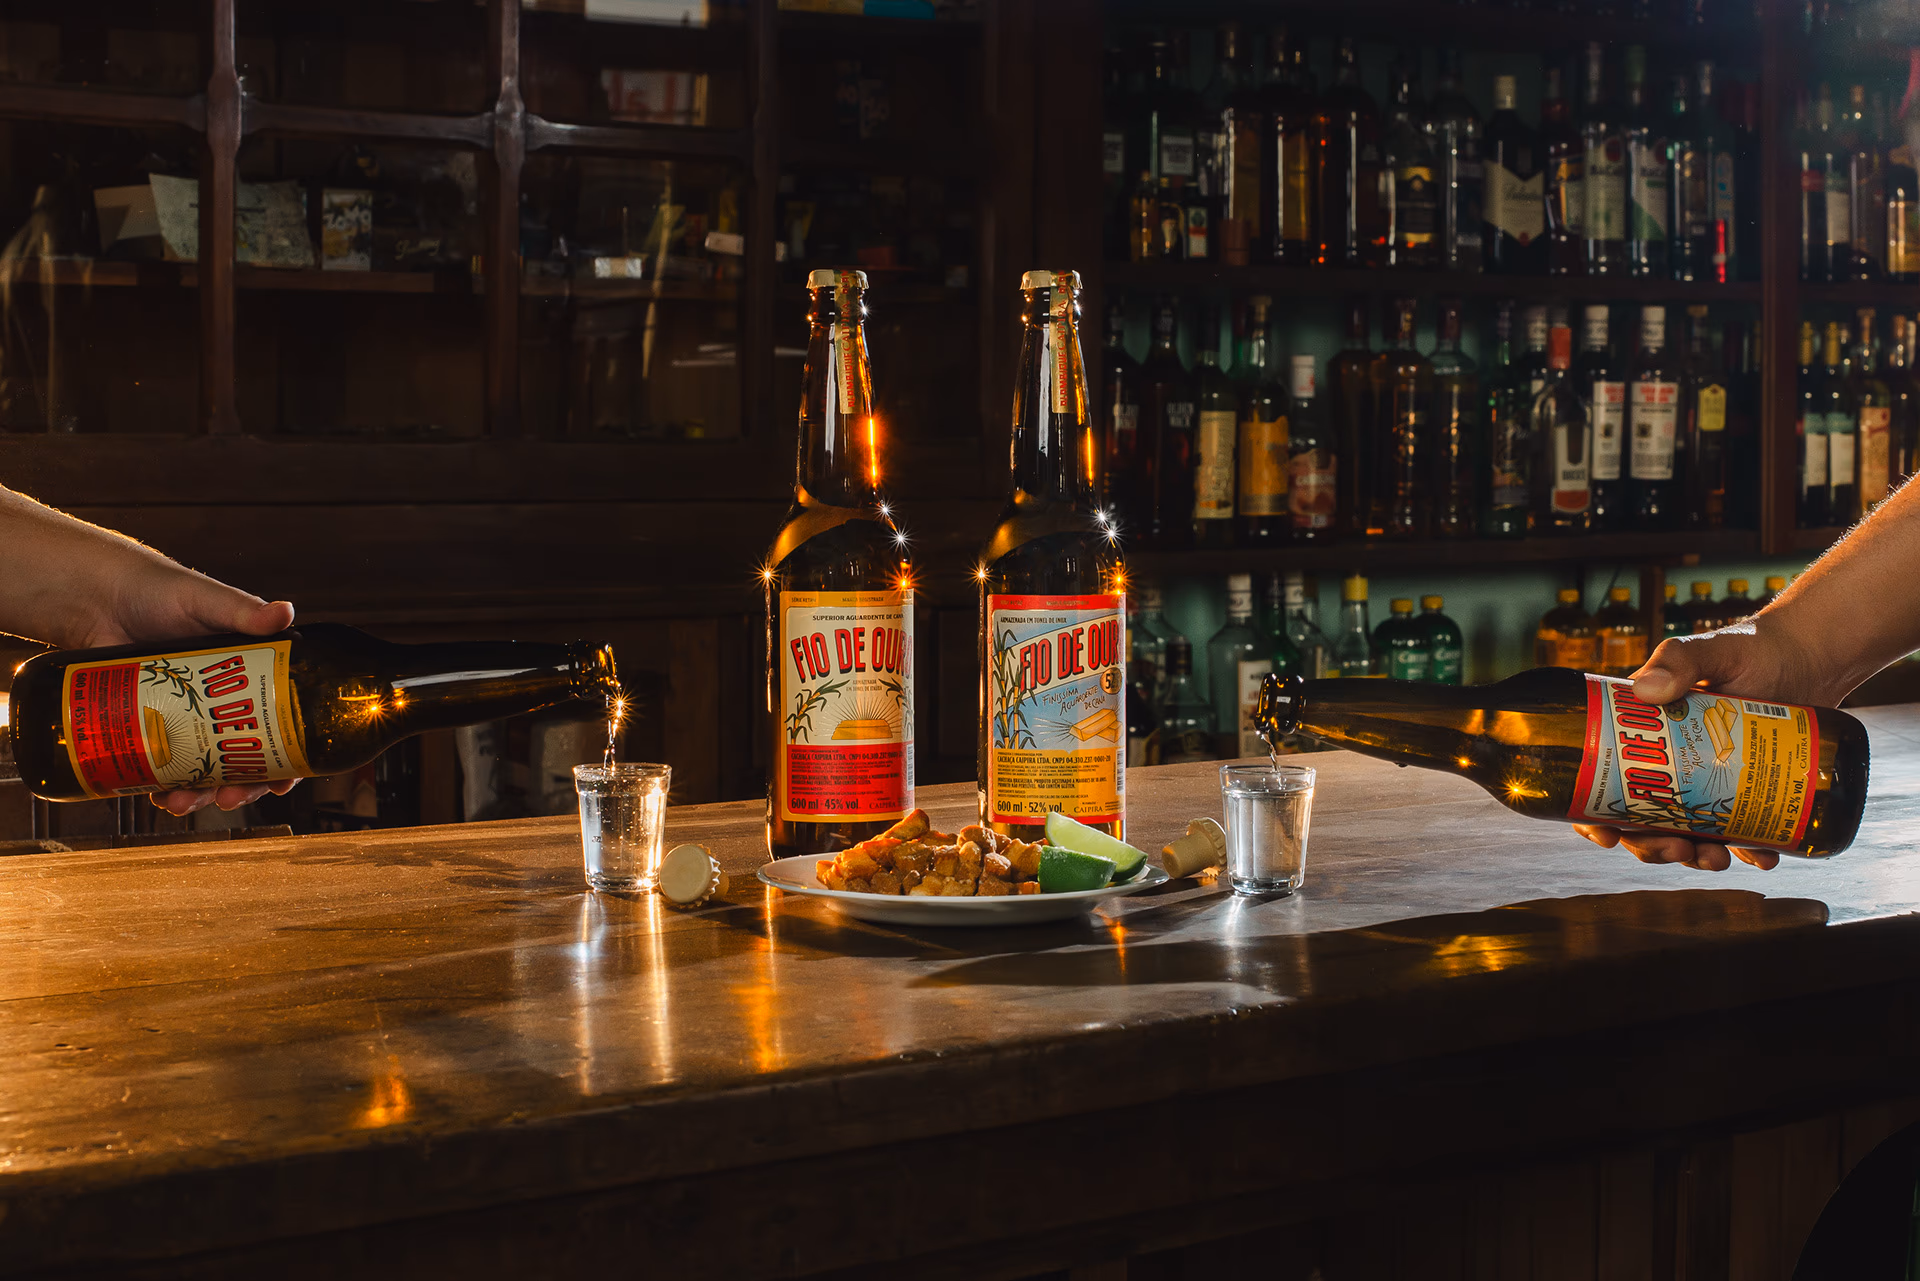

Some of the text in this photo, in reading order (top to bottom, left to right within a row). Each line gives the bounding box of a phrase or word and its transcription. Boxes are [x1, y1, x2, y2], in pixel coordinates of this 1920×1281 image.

[790, 627, 913, 684] FIO DE OURO
[1020, 638, 1052, 694] FIO
[1058, 627, 1085, 680] DE
[260, 674, 268, 708] SUPERIOR
[75, 672, 89, 744] 600 ml 45% vol.
[1059, 685, 1098, 717] AGUARDENTE
[1084, 696, 1105, 710] DE CANA
[198, 656, 269, 782] FIO DE OURO
[262, 708, 276, 749] AGUARDENTE
[1690, 717, 1704, 742] DE CANA
[1619, 732, 1670, 766] DE
[1679, 725, 1707, 770] AGUARDENTE
[1749, 720, 1758, 770] 04.310.237/0001-20
[1800, 737, 1808, 769] CAIPIRA
[275, 757, 284, 769] CANA
[997, 756, 1015, 765] CACHAÇA
[1602, 767, 1610, 781] TONEL
[1747, 771, 1755, 784] CNPJ
[1624, 767, 1675, 804] FIO
[1742, 785, 1753, 799] LTDA.
[1793, 778, 1805, 794] vol.
[791, 798, 806, 810] 600
[808, 799, 818, 809] ml
[824, 799, 844, 810] 45%
[997, 801, 1065, 813] 600 ml 52% vol.
[1074, 806, 1103, 814] CAIPIRA
[1738, 800, 1749, 819] CAIPIRA
[1787, 797, 1801, 814] 52%
[1784, 819, 1795, 829] ml
[1777, 830, 1792, 842] 600
